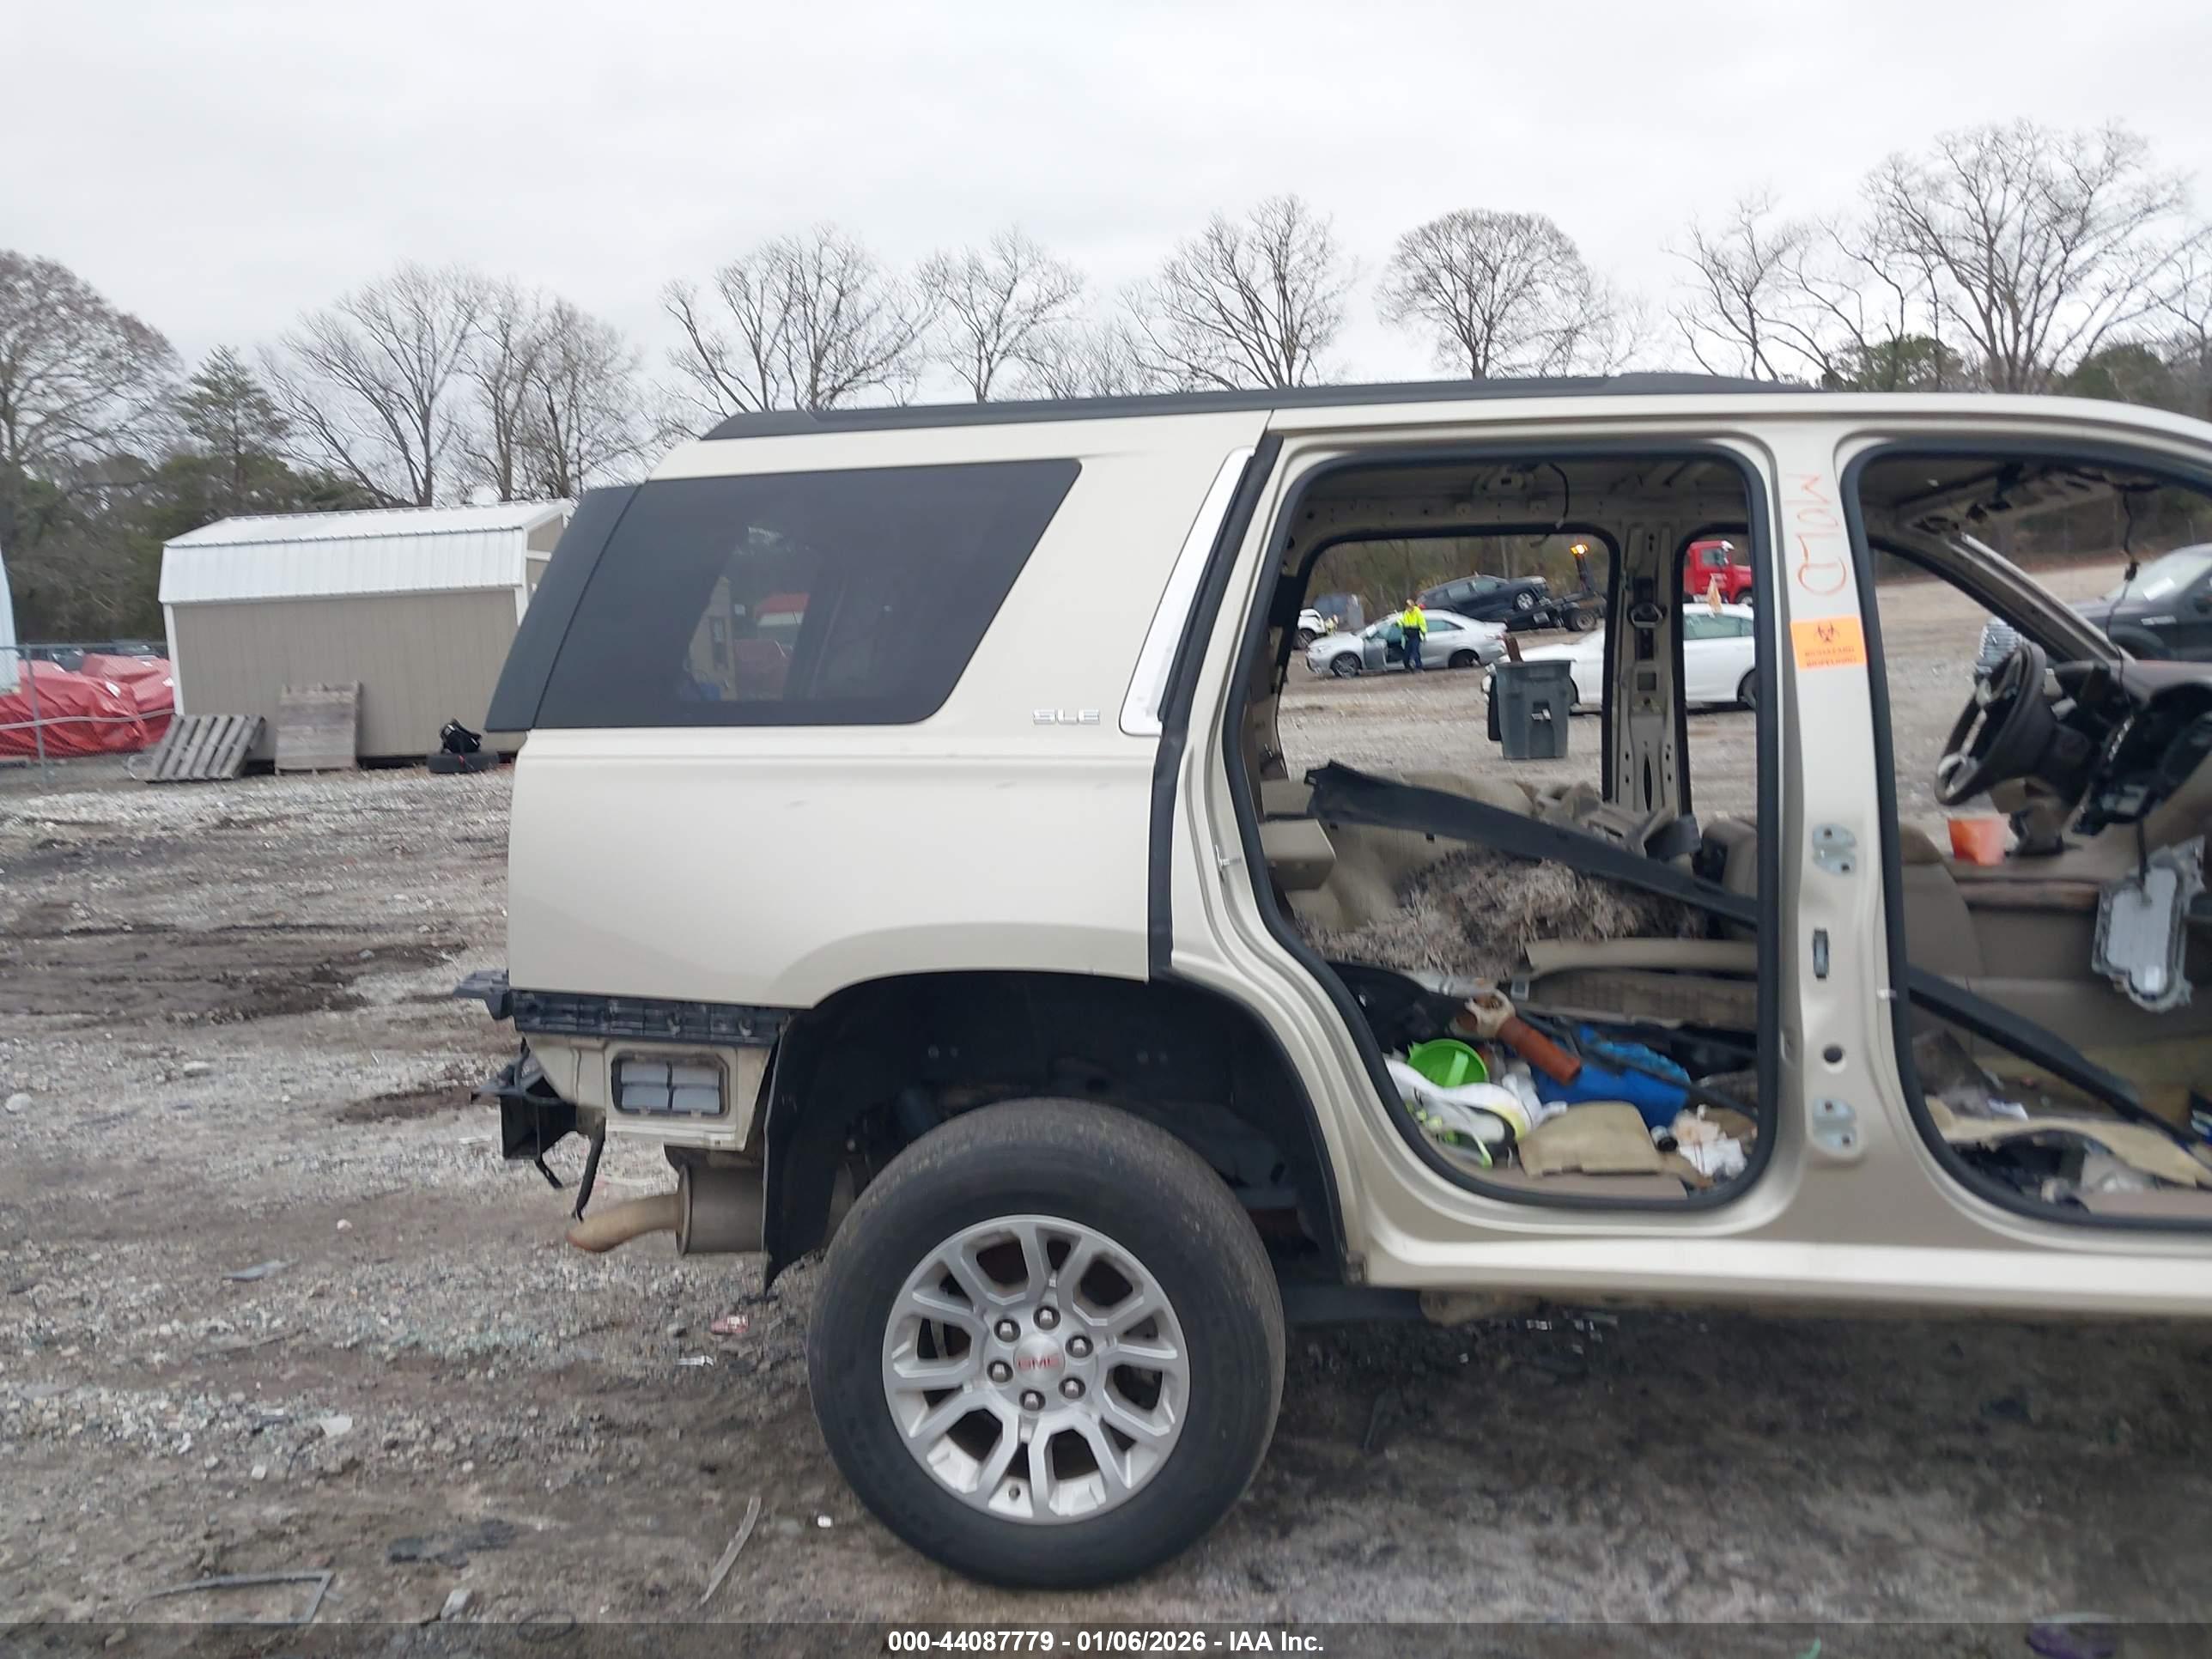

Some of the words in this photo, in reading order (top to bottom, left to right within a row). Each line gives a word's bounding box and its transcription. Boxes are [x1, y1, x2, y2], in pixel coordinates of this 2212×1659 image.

[1784, 473, 1847, 595] MOLD
[1032, 708, 1100, 725] SLE
[1018, 1356, 1060, 1371] GMC
